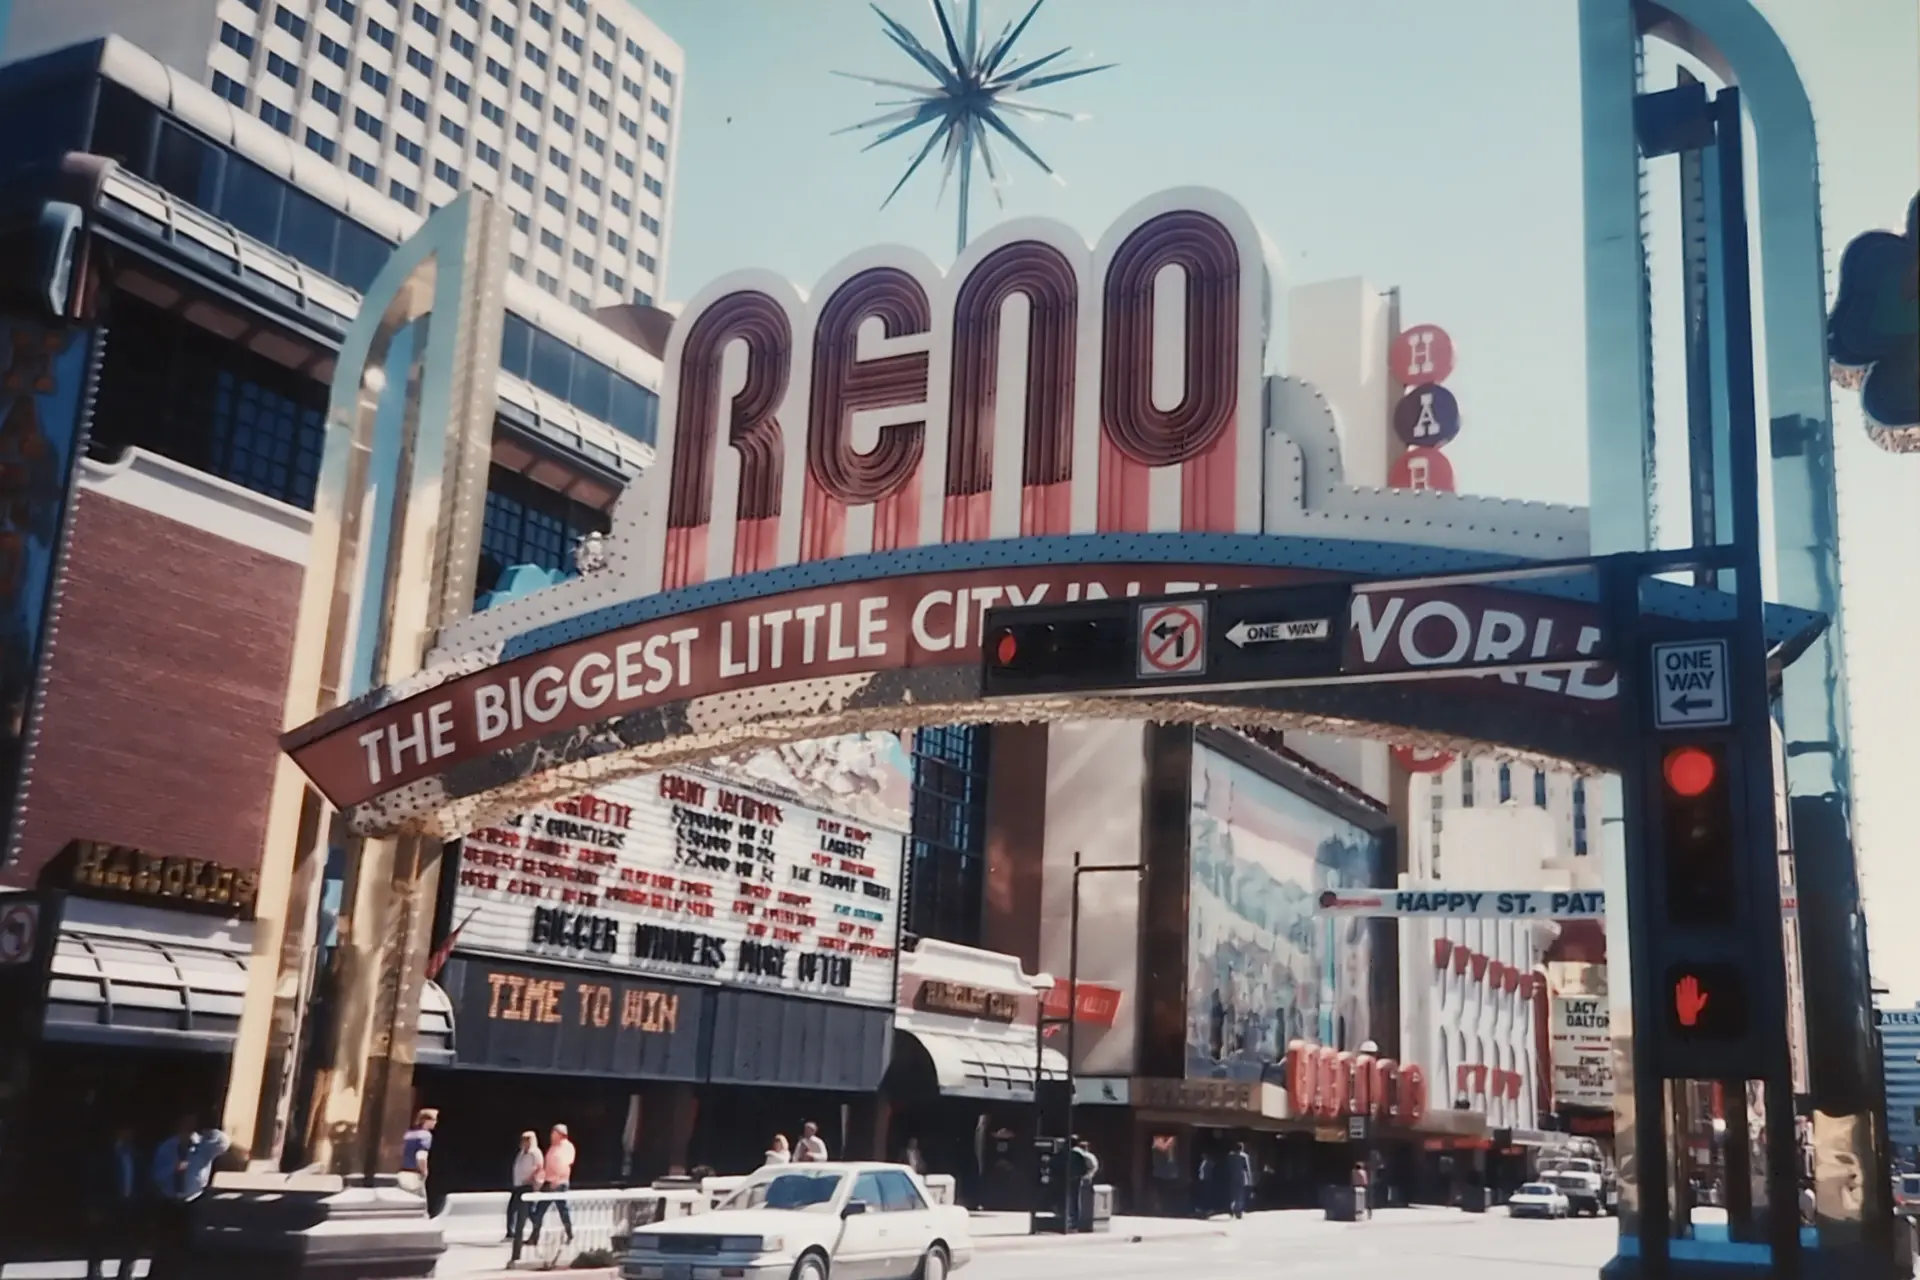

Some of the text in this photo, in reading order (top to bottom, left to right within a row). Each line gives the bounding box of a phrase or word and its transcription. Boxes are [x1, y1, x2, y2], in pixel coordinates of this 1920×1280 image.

[1247, 622, 1320, 641] ONE WAY
[1665, 649, 1713, 671] ONE
[358, 700, 457, 785] THE
[474, 628, 700, 742] BIGGEST
[718, 596, 890, 679] LITTLE
[1664, 670, 1715, 692] WAY
[1395, 893, 1483, 913] HAPPY
[1496, 893, 1537, 914] ST.
[532, 905, 619, 954] BIGGER
[634, 922, 727, 969] WINNERS
[737, 938, 788, 979] MORE
[798, 951, 852, 987] OFTEN
[488, 973, 679, 1034] TIME TO WIN
[1565, 1001, 1598, 1014] LACY
